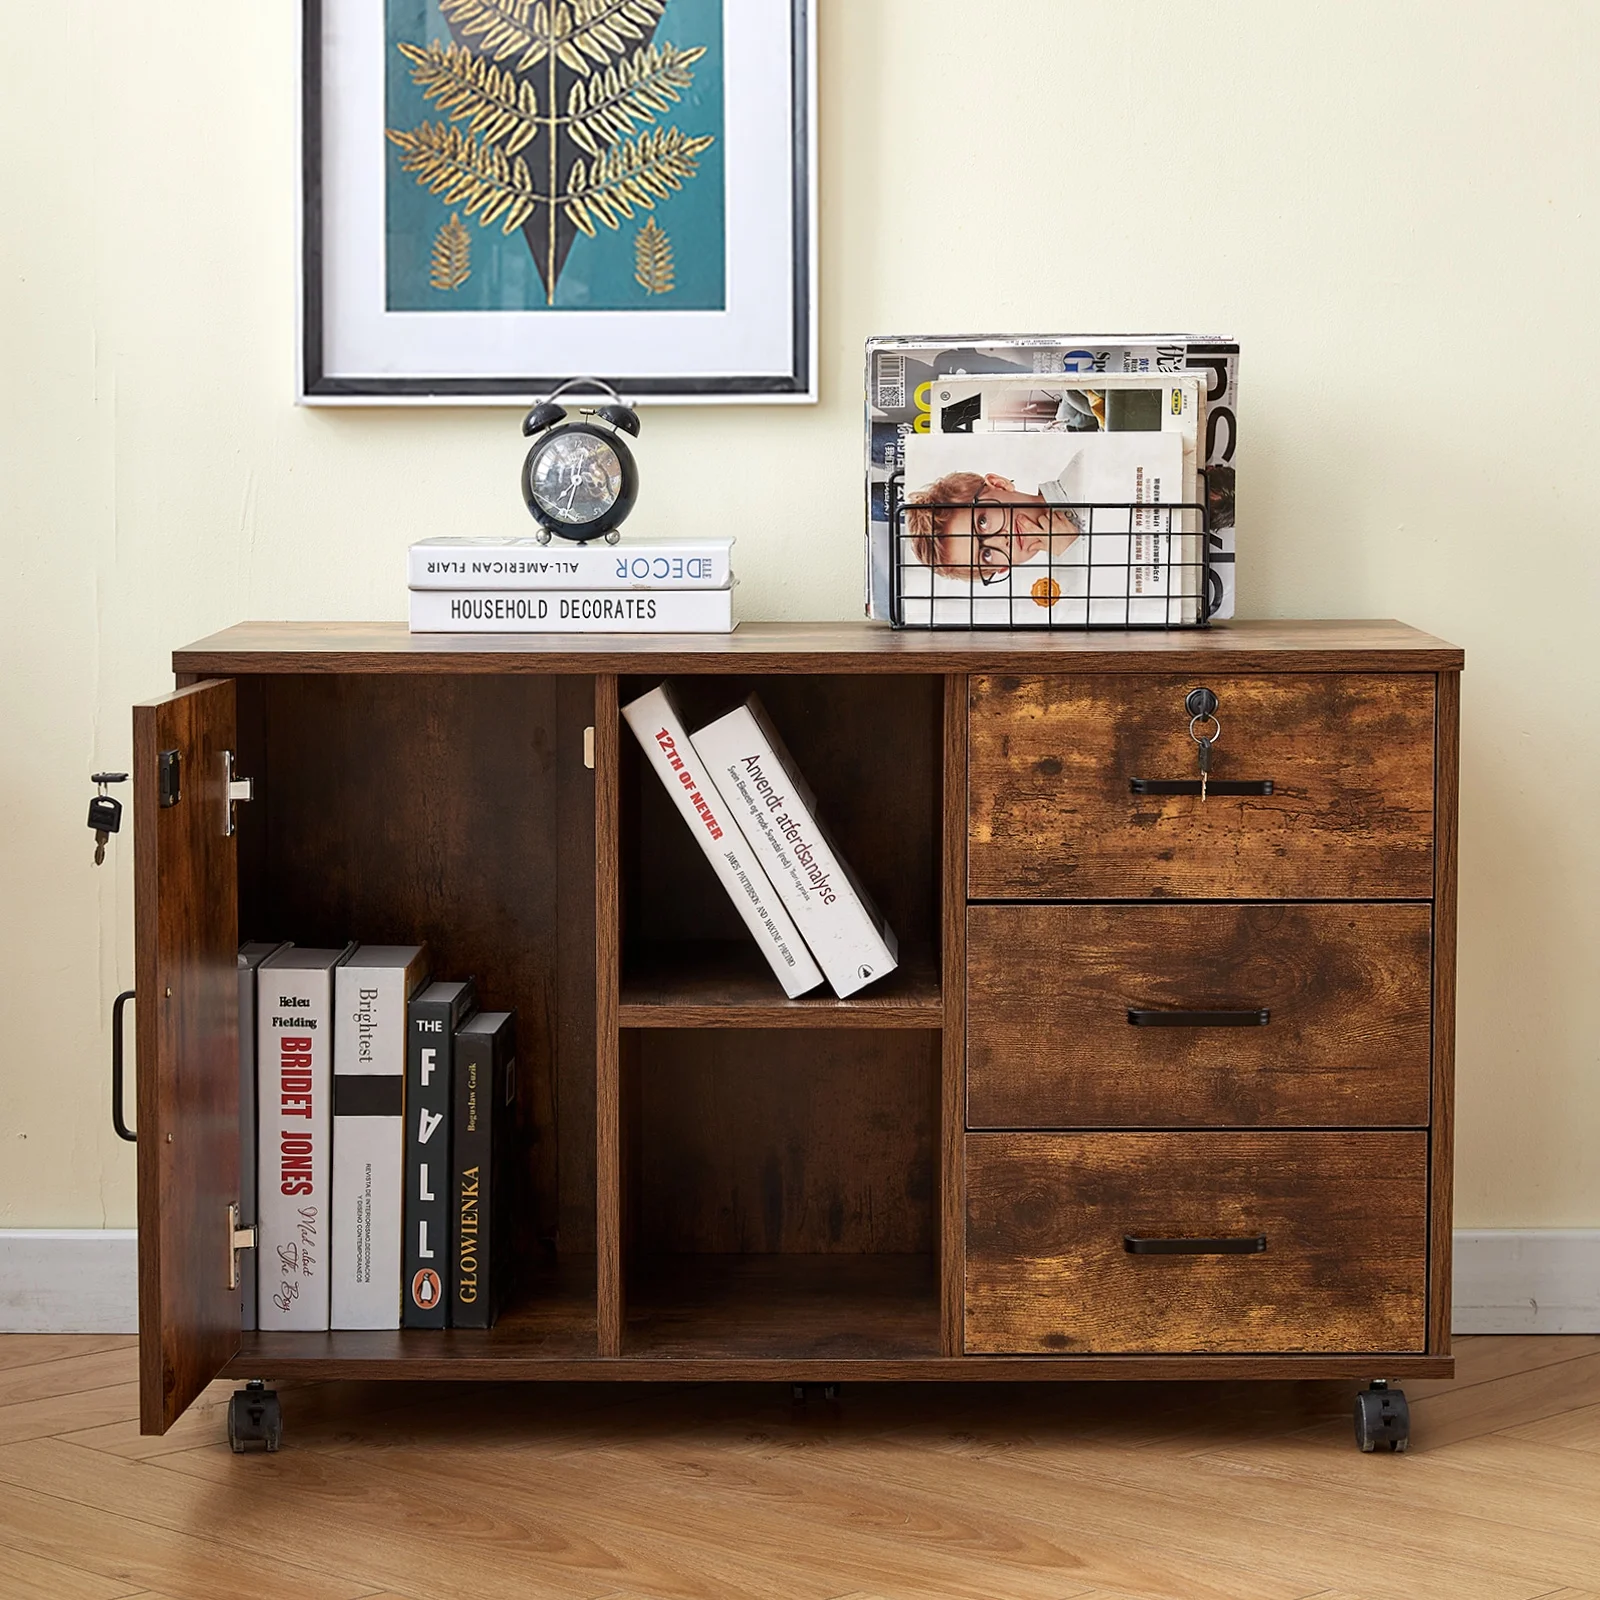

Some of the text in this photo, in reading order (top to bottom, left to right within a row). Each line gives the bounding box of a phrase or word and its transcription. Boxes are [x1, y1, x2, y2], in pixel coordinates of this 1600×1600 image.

[426, 561, 580, 574] ALL-AMERICAN FLAIR
[615, 557, 713, 579] ELLE DECOR
[451, 598, 657, 619] HOUSEHOLD DECORATES
[655, 727, 724, 841] 12TH OF NEVER
[749, 804, 759, 816] og
[740, 754, 837, 906] Anvendt atferdsanalyse
[272, 1017, 317, 1030] Fielding
[352, 987, 378, 1063] Brightest
[416, 1020, 443, 1032] THE
[467, 1062, 477, 1086] Guzik
[281, 1037, 313, 1196] BRIDET JONES
[297, 1206, 318, 1278] Mad about
[459, 1166, 479, 1303] GŁOWIENKA
[277, 1241, 299, 1276] The
